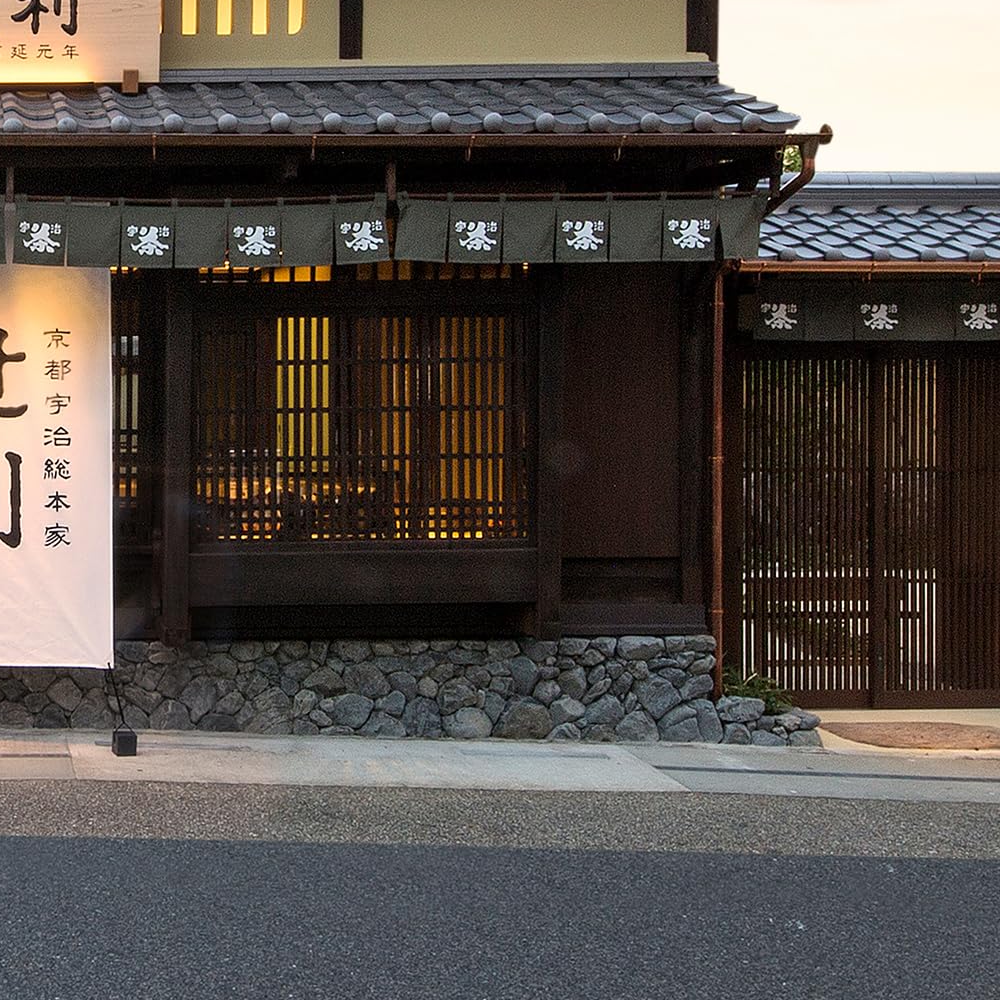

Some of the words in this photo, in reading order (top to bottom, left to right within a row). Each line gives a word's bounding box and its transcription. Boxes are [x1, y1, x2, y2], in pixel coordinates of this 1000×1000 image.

[43, 327, 72, 548] 京都宇治総本家
